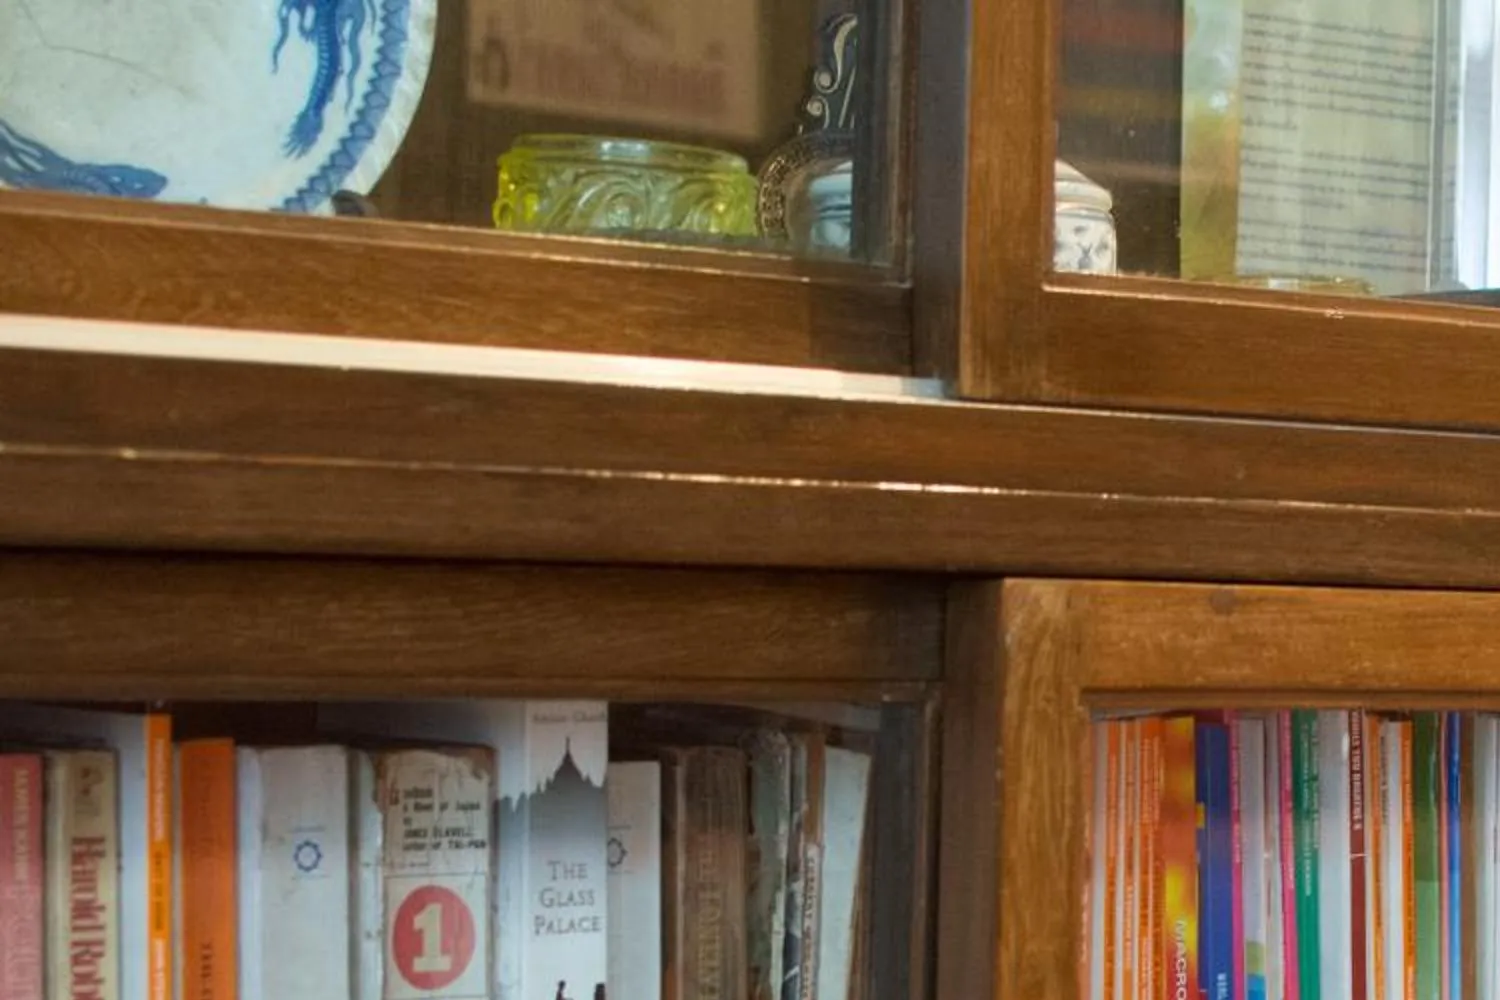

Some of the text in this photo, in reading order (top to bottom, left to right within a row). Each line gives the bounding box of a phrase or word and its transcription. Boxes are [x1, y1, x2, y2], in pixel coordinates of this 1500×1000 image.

[548, 860, 589, 882] THE
[70, 836, 107, 932] Harold
[539, 887, 596, 909] GLASS
[413, 902, 452, 972] 1
[534, 914, 604, 937] PALACE
